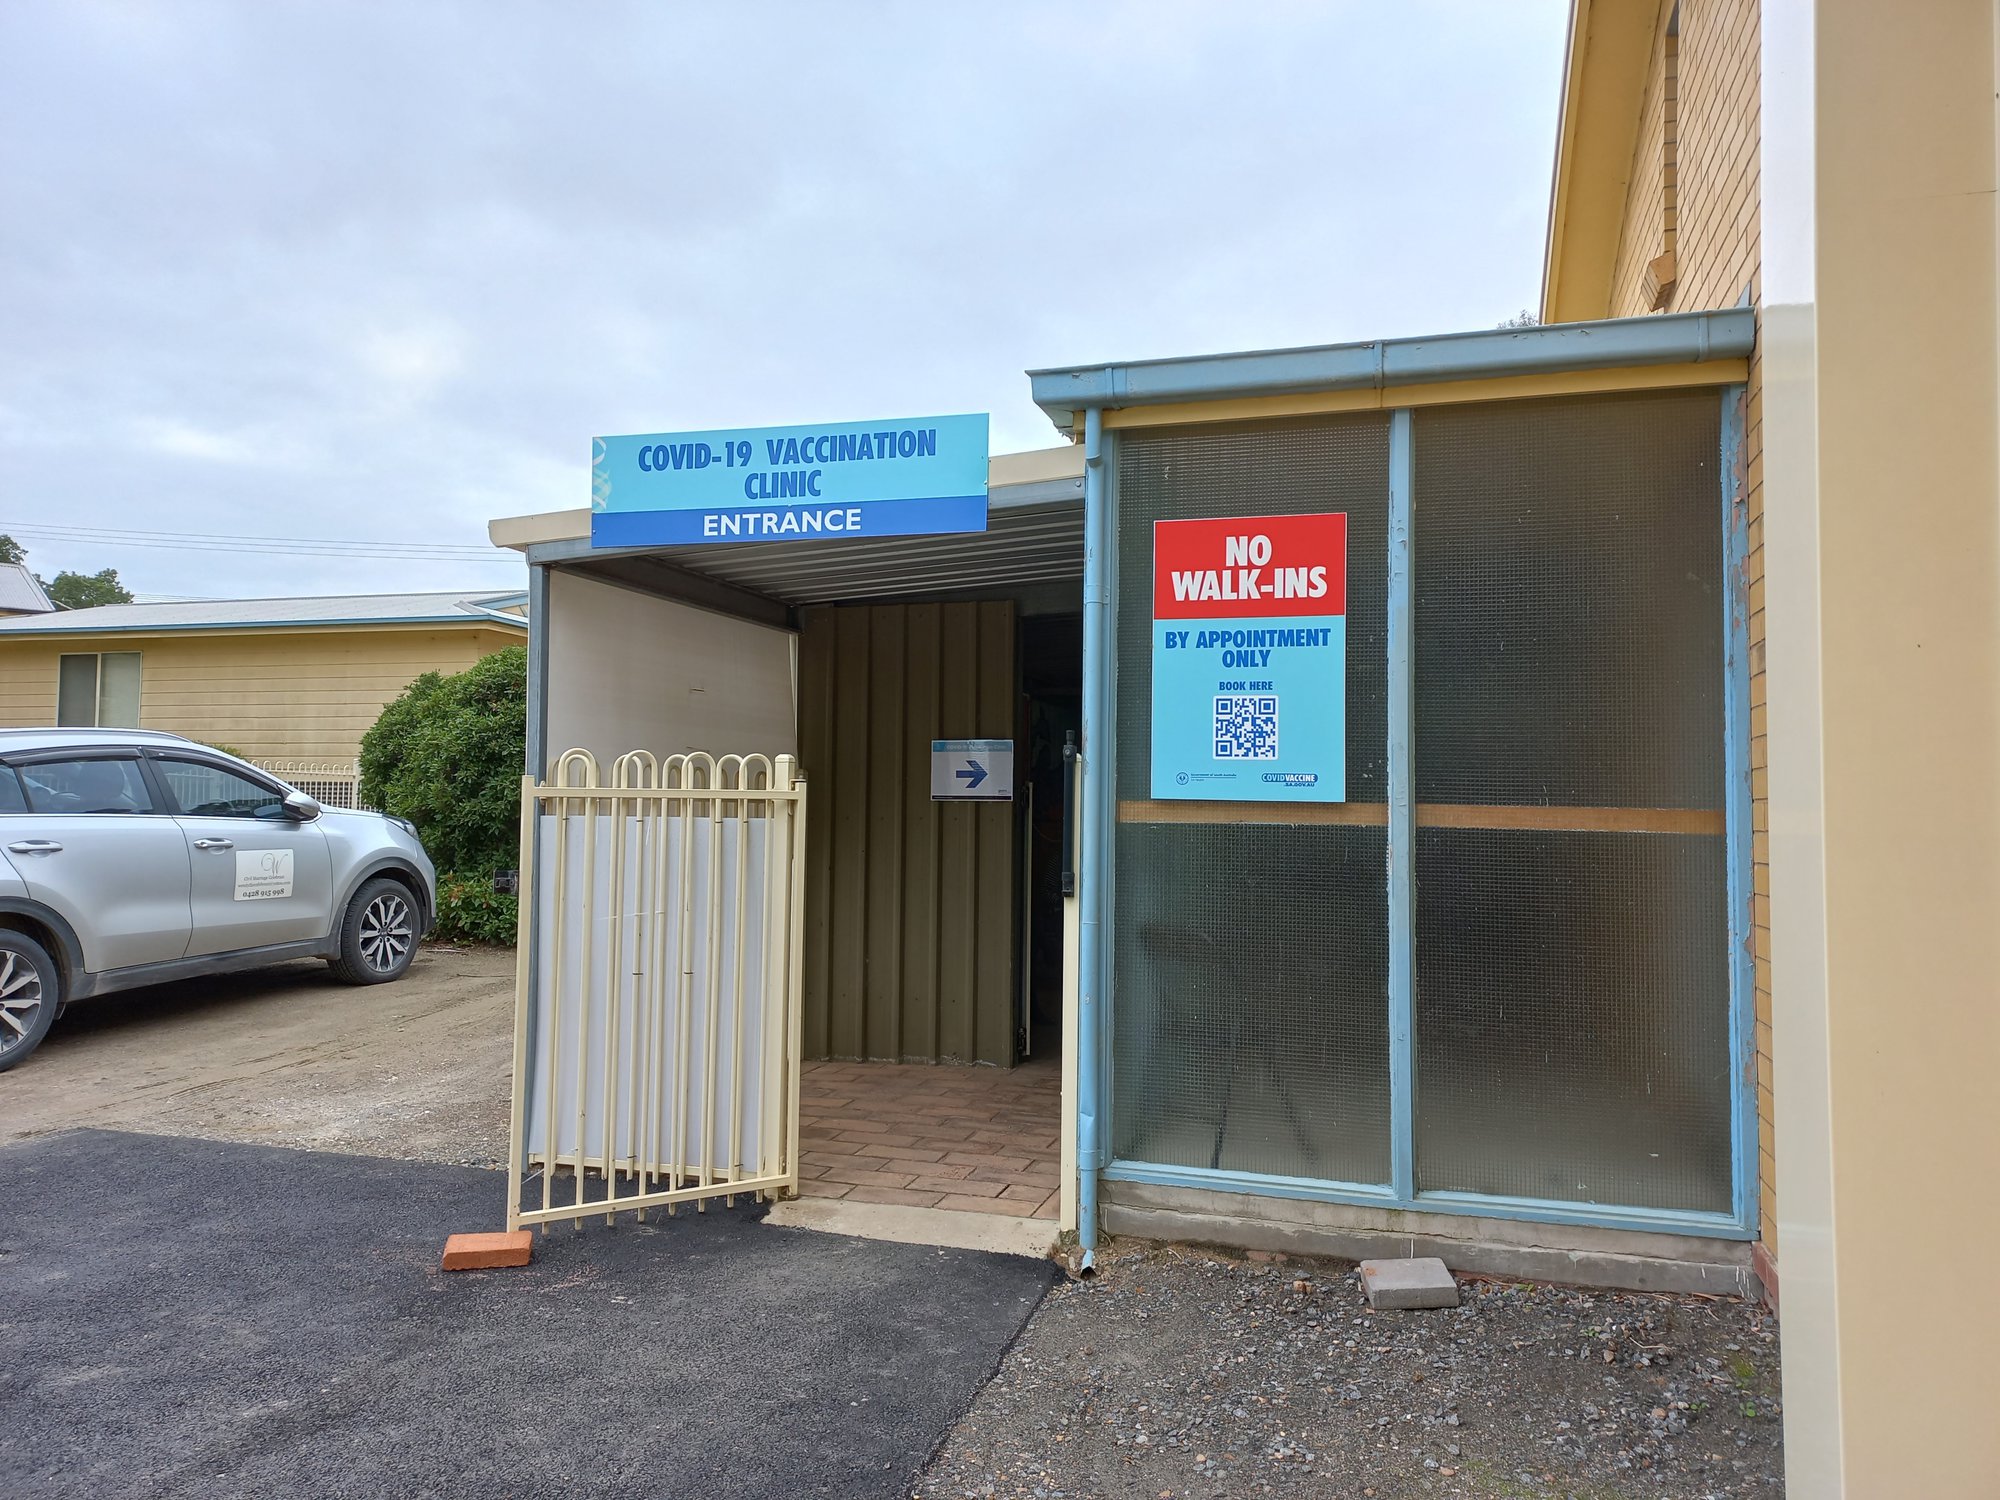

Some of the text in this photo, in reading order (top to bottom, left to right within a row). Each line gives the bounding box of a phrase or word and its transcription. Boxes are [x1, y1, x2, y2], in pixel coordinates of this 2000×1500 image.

[638, 428, 937, 472] COVID-19 VACCINATION
[744, 469, 822, 500] CLINIC
[703, 508, 862, 537] ENTRANCE
[1225, 534, 1273, 567] NO
[1171, 566, 1328, 601] WALK-INS
[1165, 628, 1331, 649] BY APPOINTMENT
[1222, 649, 1271, 668] ONLY
[1218, 681, 1273, 691] BOOK HERE
[243, 890, 259, 898] 0428
